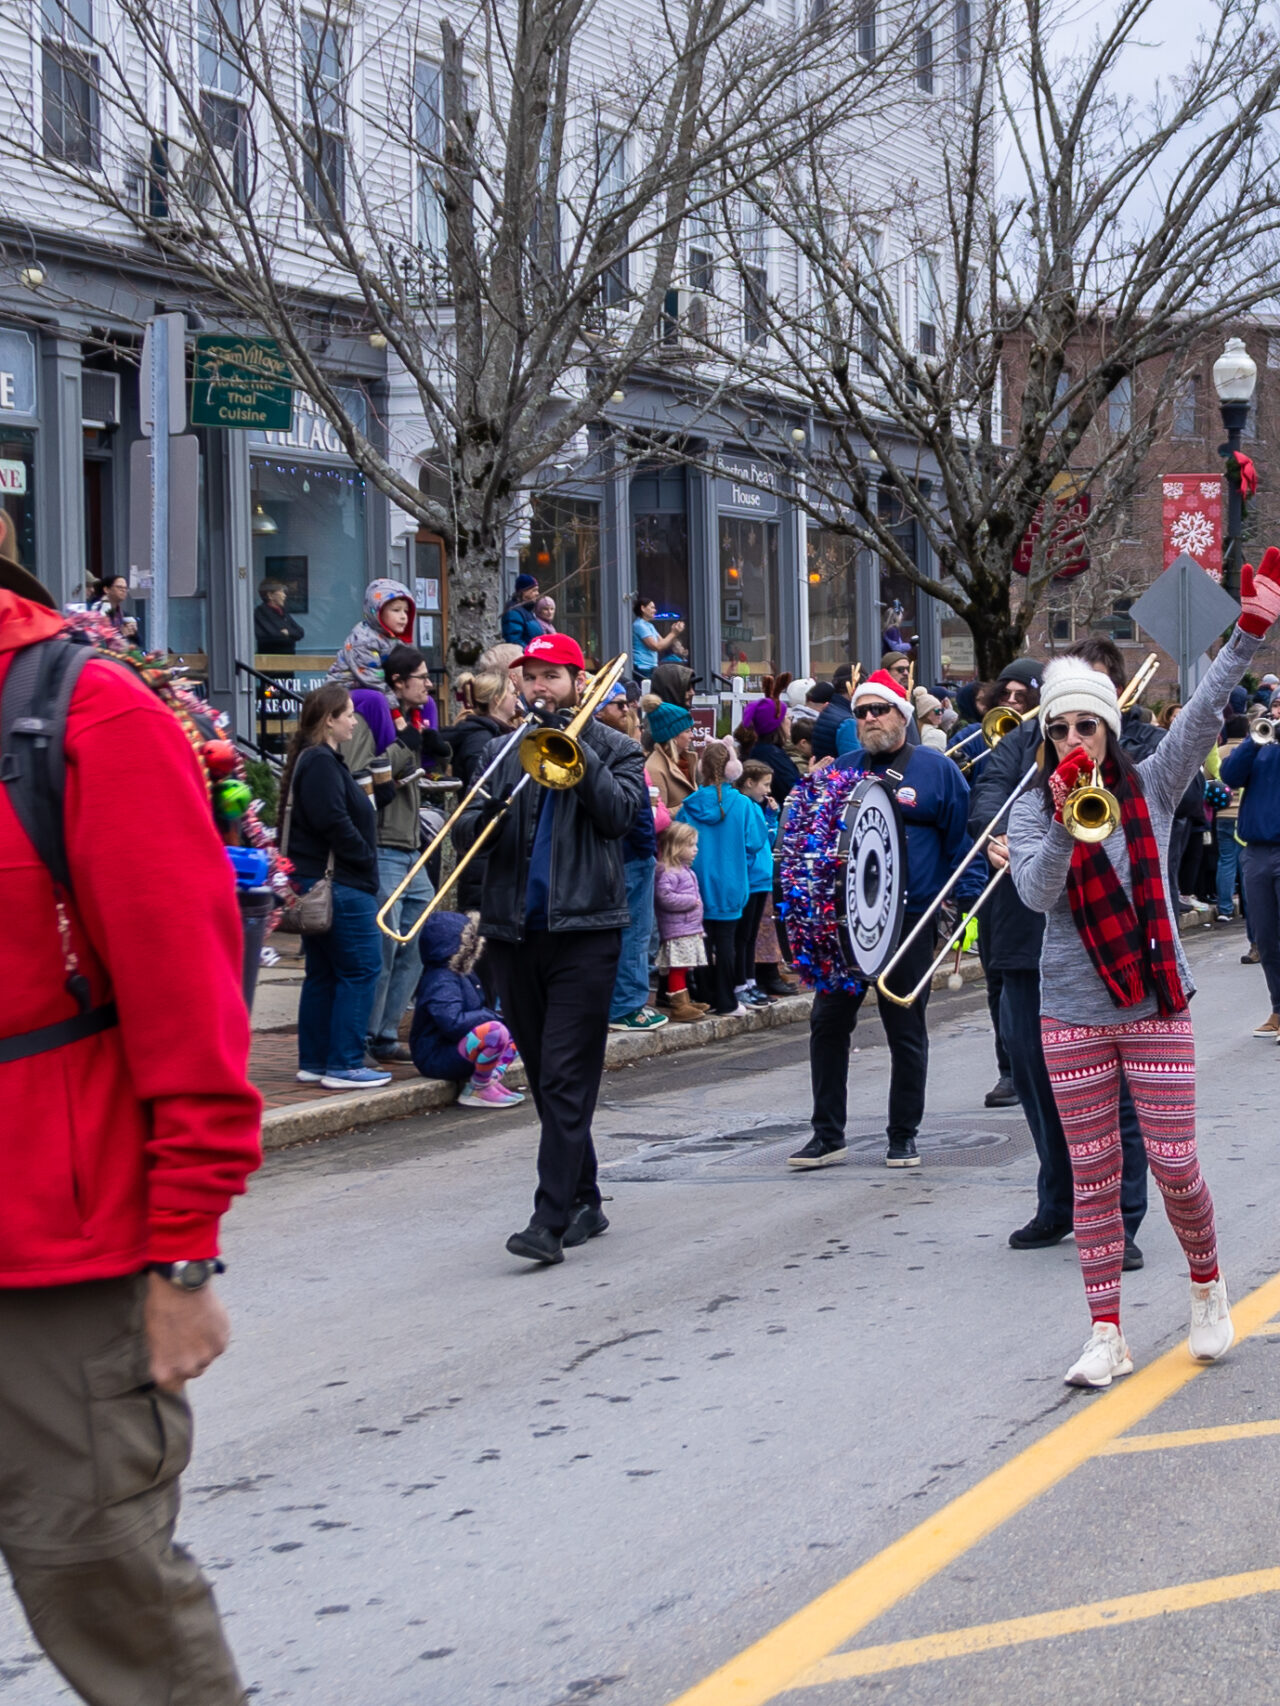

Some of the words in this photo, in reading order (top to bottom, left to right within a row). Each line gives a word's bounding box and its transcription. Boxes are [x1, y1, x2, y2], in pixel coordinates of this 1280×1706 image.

[235, 344, 286, 373] Village
[228, 391, 256, 405] Thai
[293, 389, 327, 418] IA
[218, 406, 267, 421] Cuisine
[265, 416, 347, 453] LLAG
[750, 463, 774, 485] Bean
[732, 484, 761, 506] House
